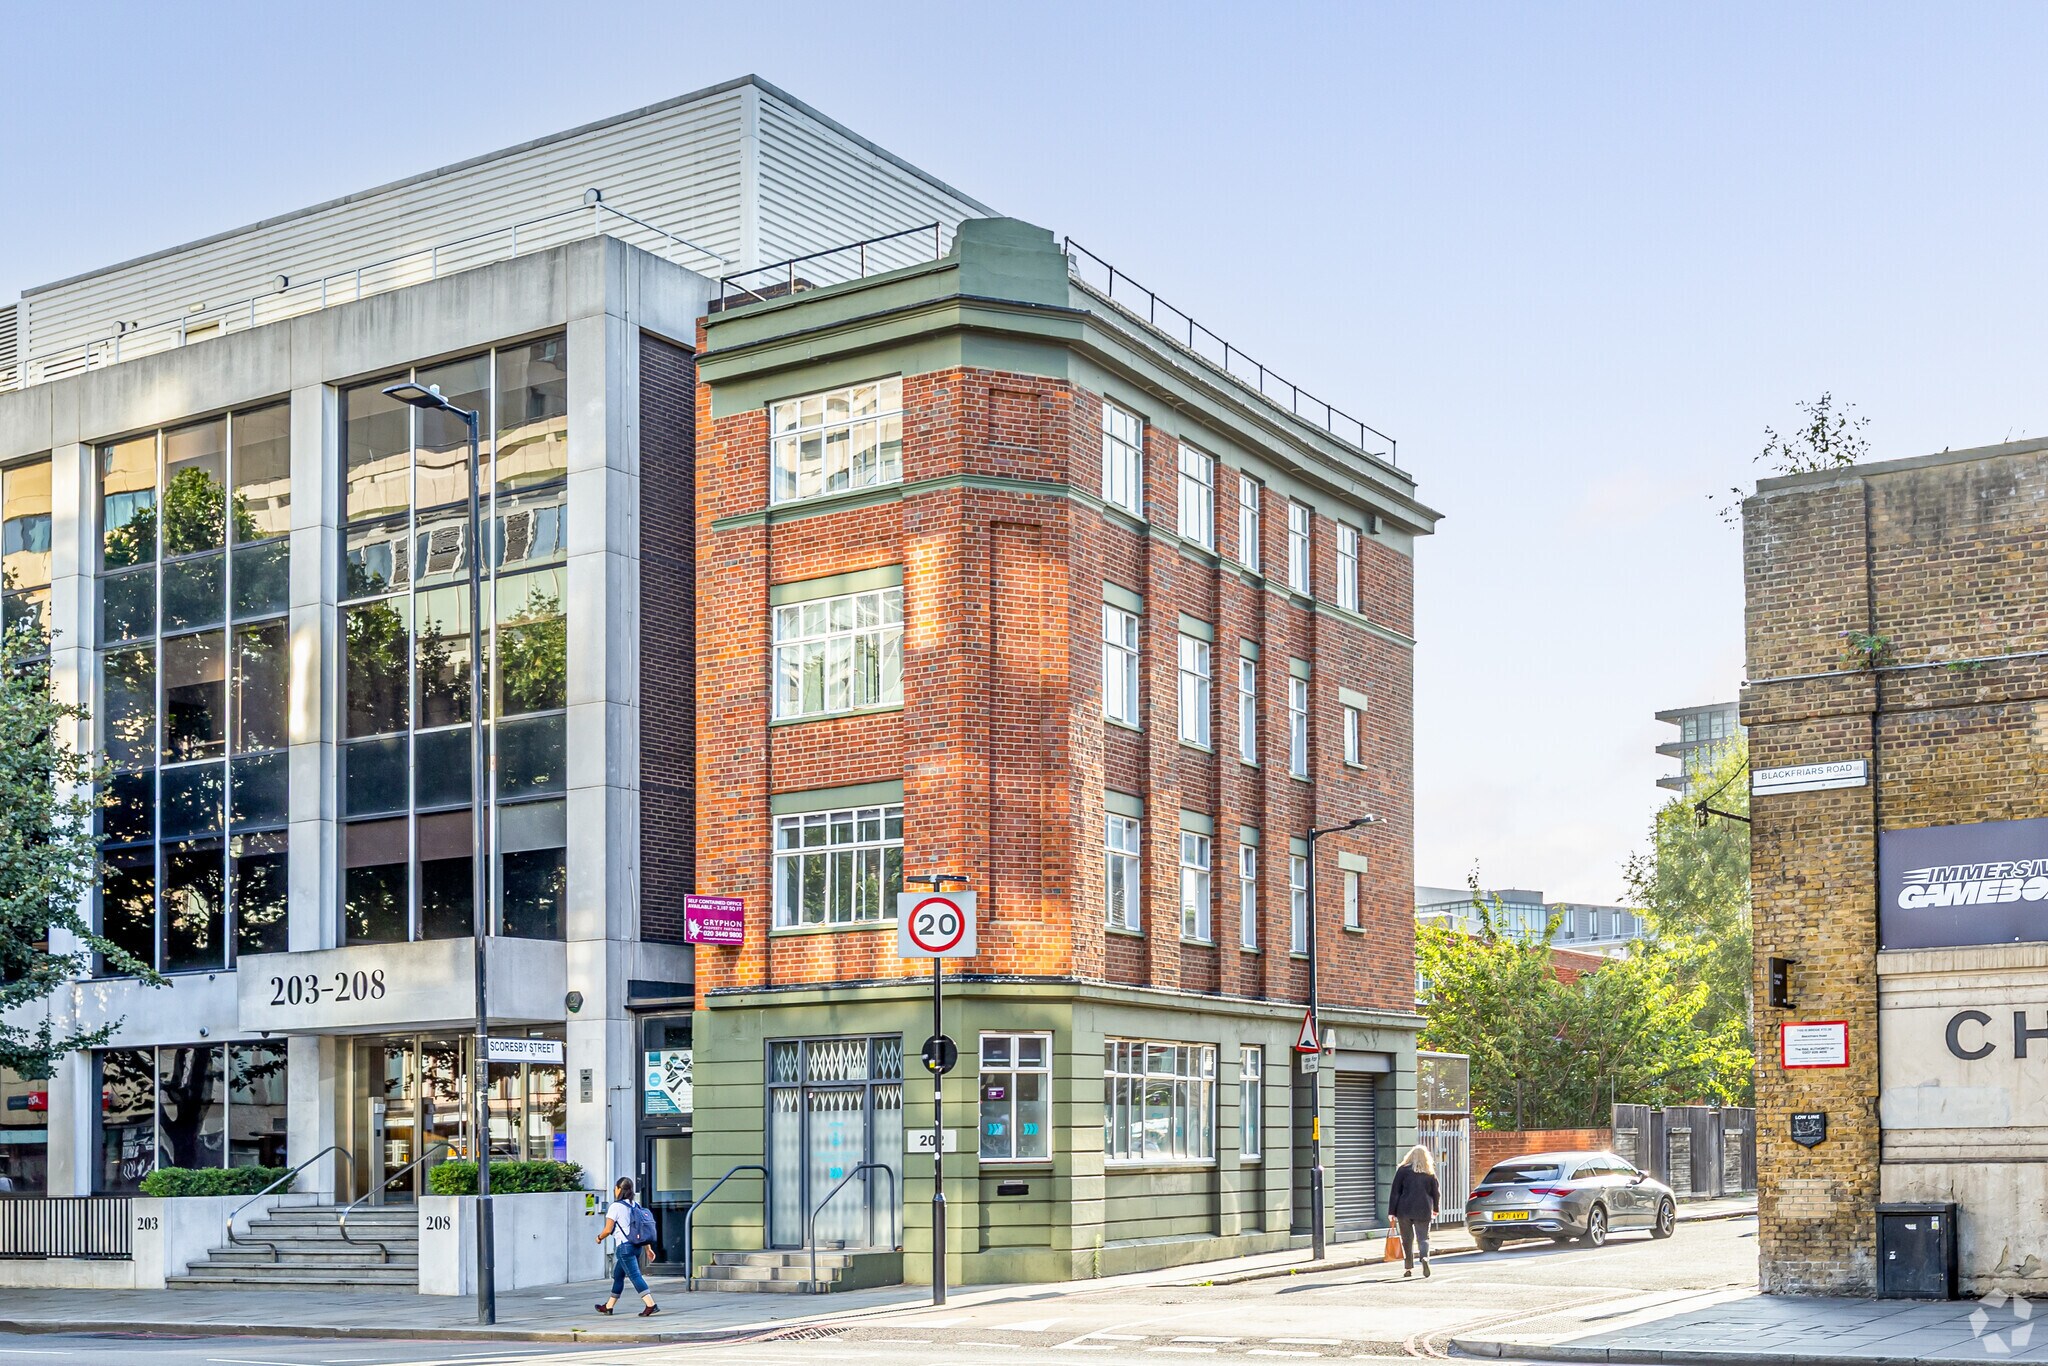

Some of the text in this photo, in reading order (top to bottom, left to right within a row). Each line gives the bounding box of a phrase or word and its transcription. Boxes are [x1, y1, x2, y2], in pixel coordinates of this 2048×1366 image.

[1761, 766, 1824, 780] BLACKFRIARS
[1826, 764, 1852, 774] ROAD
[1897, 876, 2048, 910] GAMEBO
[703, 919, 742, 927] GRYPHON
[918, 914, 957, 935] 20
[270, 969, 386, 1006] 203-208
[490, 1041, 555, 1053] SCORESBY STREET
[137, 1217, 158, 1230] 203
[426, 1216, 451, 1230] 208
